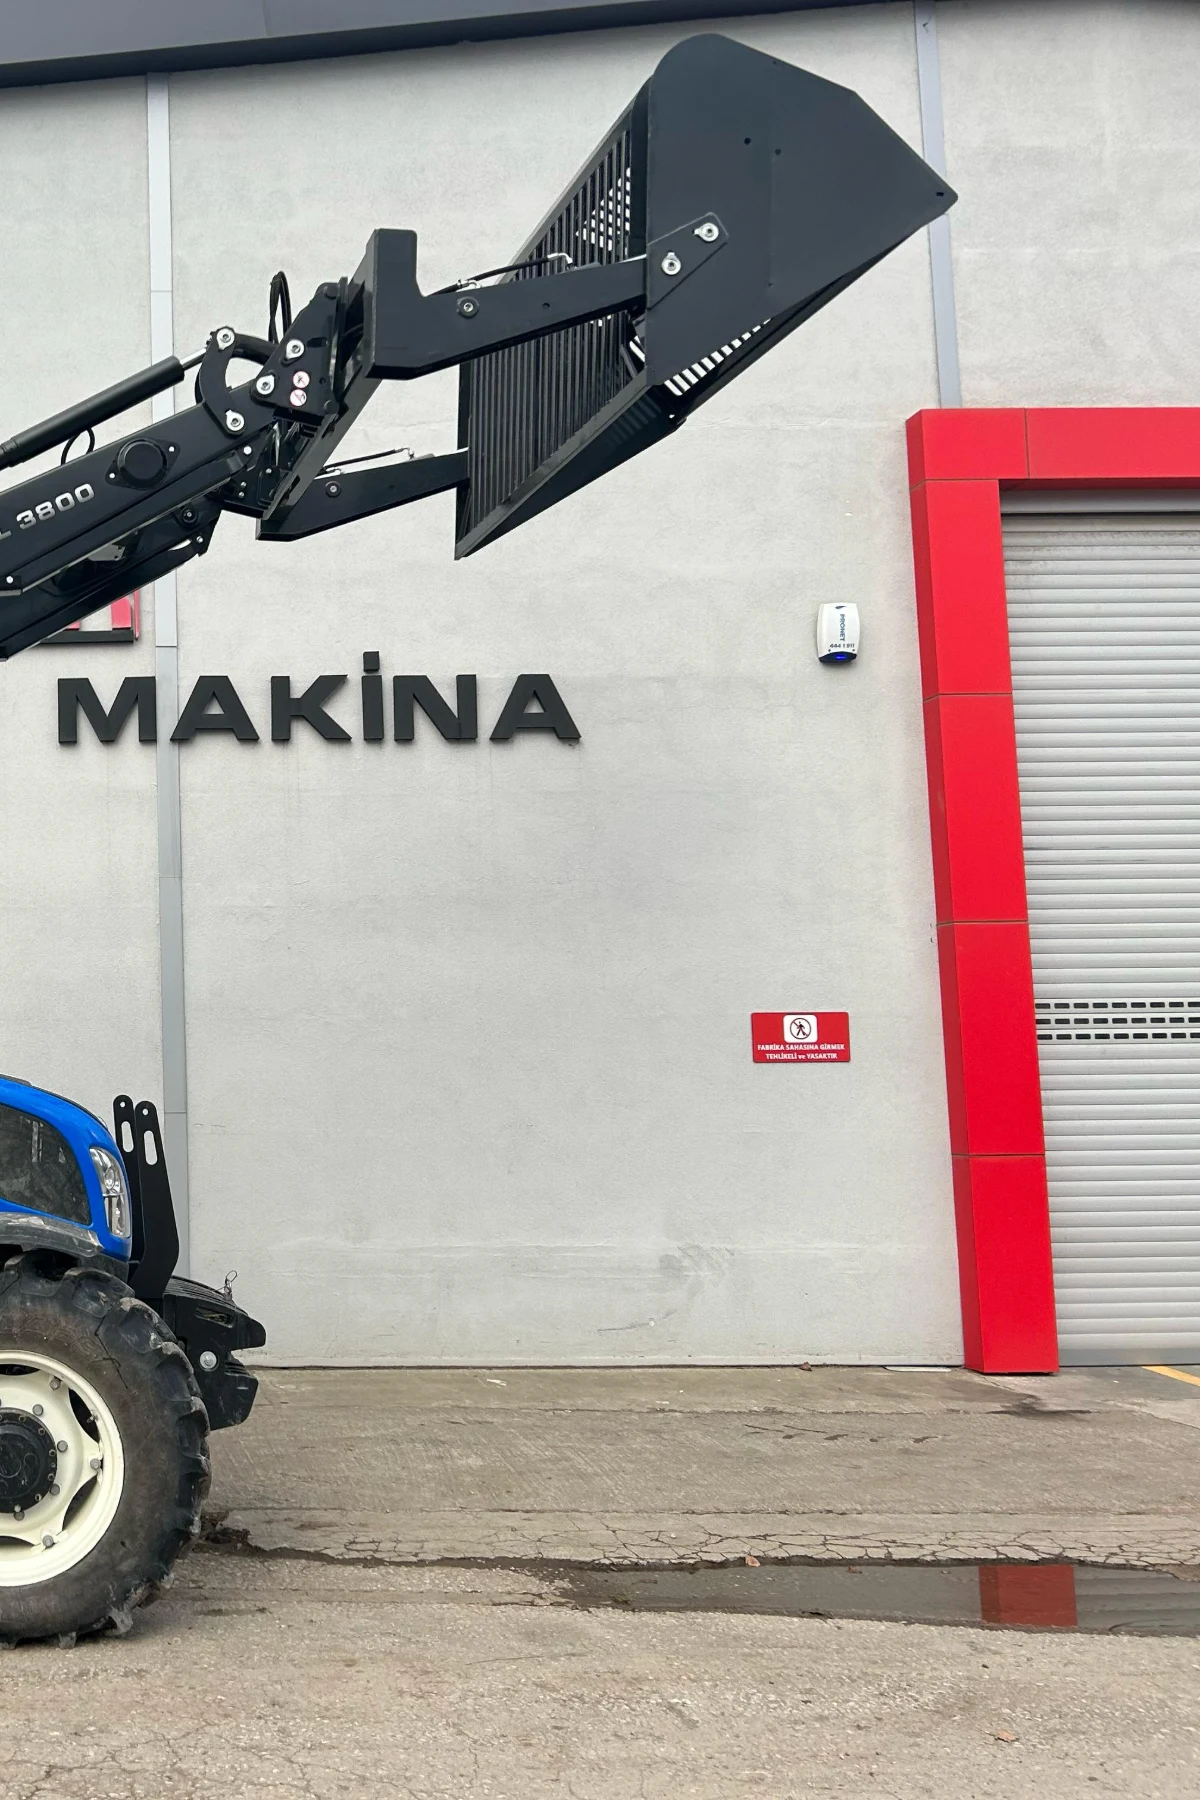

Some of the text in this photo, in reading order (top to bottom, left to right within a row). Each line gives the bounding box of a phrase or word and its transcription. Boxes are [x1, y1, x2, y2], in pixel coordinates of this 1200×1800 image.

[16, 483, 95, 530] 3800
[58, 651, 581, 743] MAKİNA
[757, 1043, 785, 1051] FABRİKA
[785, 1043, 819, 1051] SAHASINA
[765, 1052, 797, 1060] TEHLİKELİ
